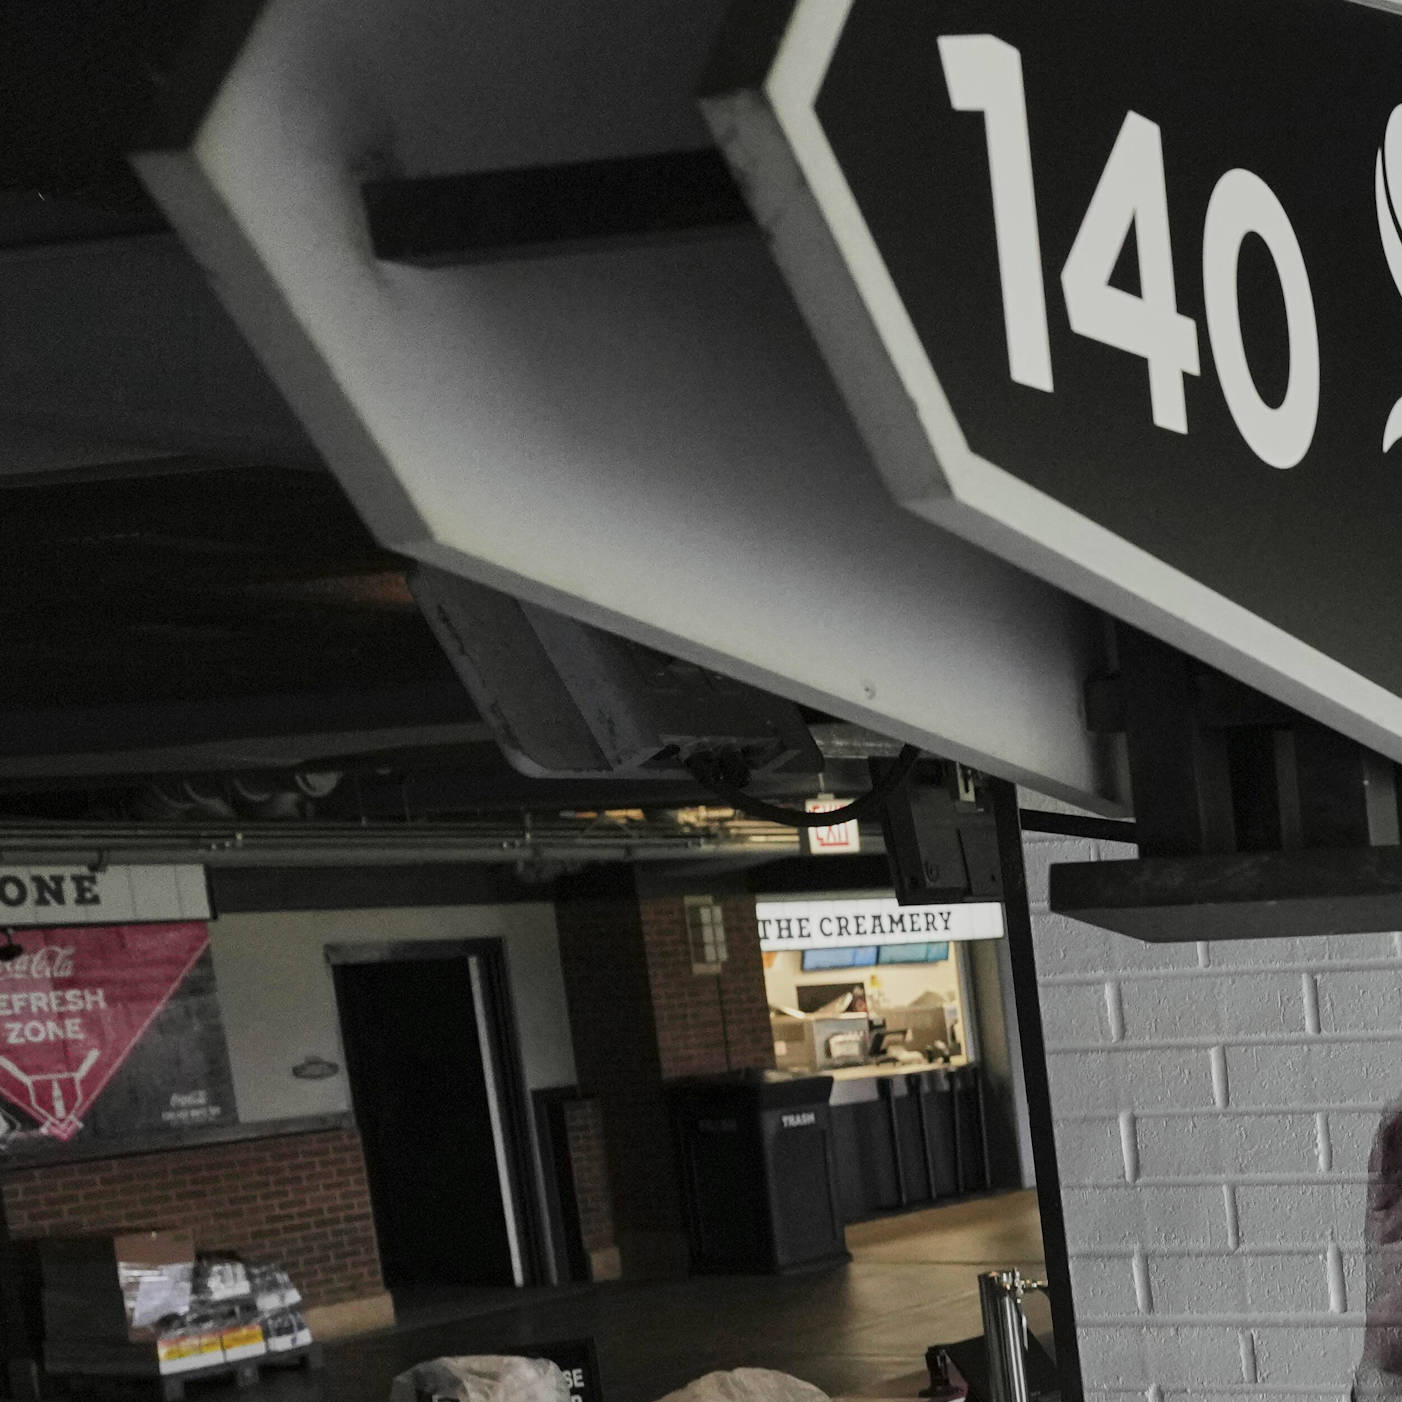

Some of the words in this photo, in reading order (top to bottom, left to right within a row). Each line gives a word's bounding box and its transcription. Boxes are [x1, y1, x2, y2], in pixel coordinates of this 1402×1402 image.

[937, 33, 1320, 470] 140
[757, 917, 812, 940] THE
[818, 910, 952, 937] CREAMERY
[5, 1018, 84, 1044] ZONE
